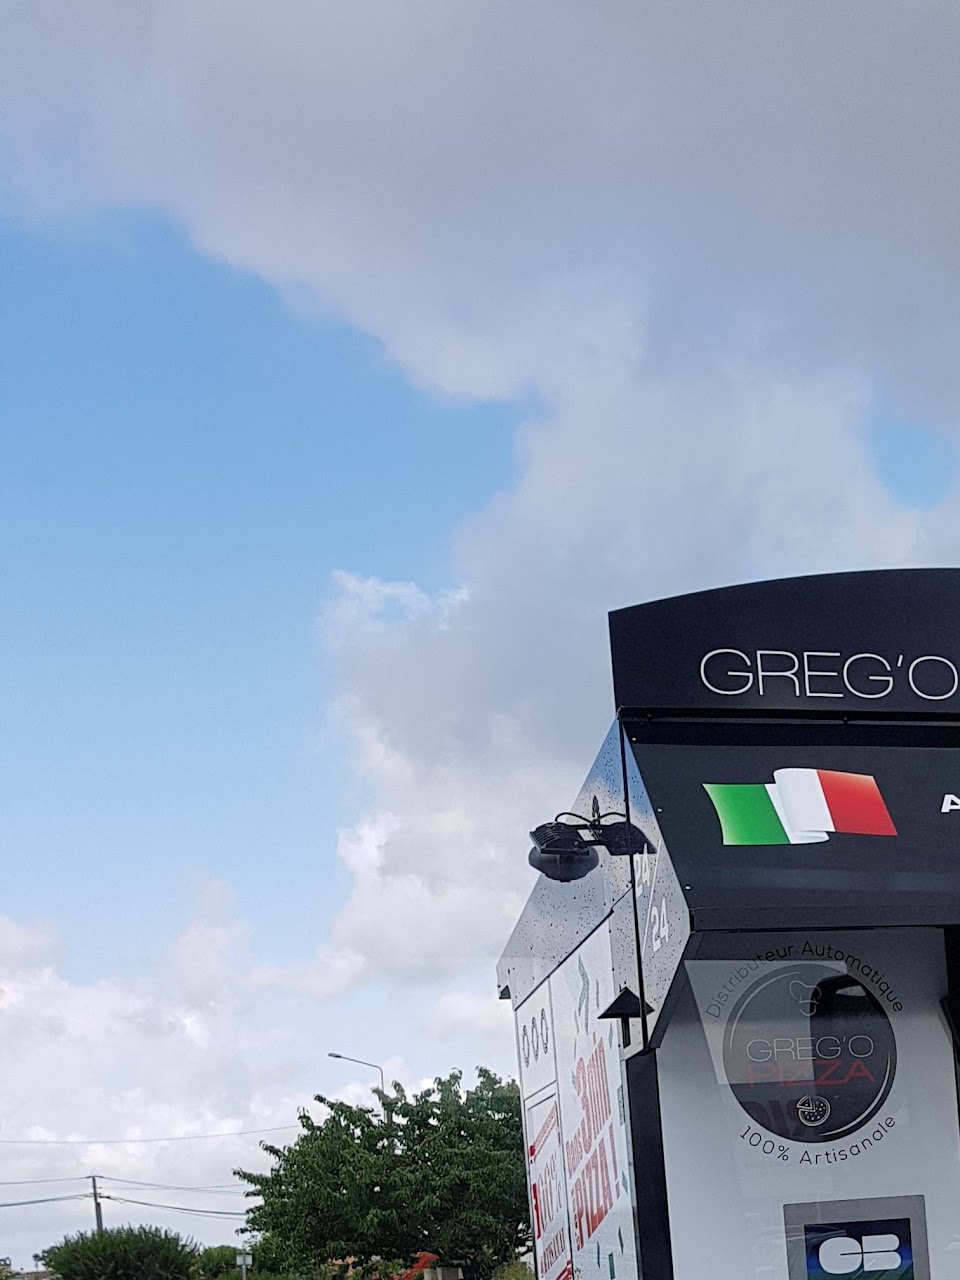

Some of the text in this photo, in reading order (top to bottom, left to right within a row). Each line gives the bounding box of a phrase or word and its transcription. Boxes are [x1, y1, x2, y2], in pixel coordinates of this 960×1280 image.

[700, 649, 959, 700] GREG'O
[650, 896, 669, 952] 24
[706, 940, 903, 1019] Distributeur Automatique
[746, 1035, 874, 1062] GREG'O
[747, 1058, 876, 1088] PIZZA
[739, 1116, 896, 1165] 100% Artisanale
